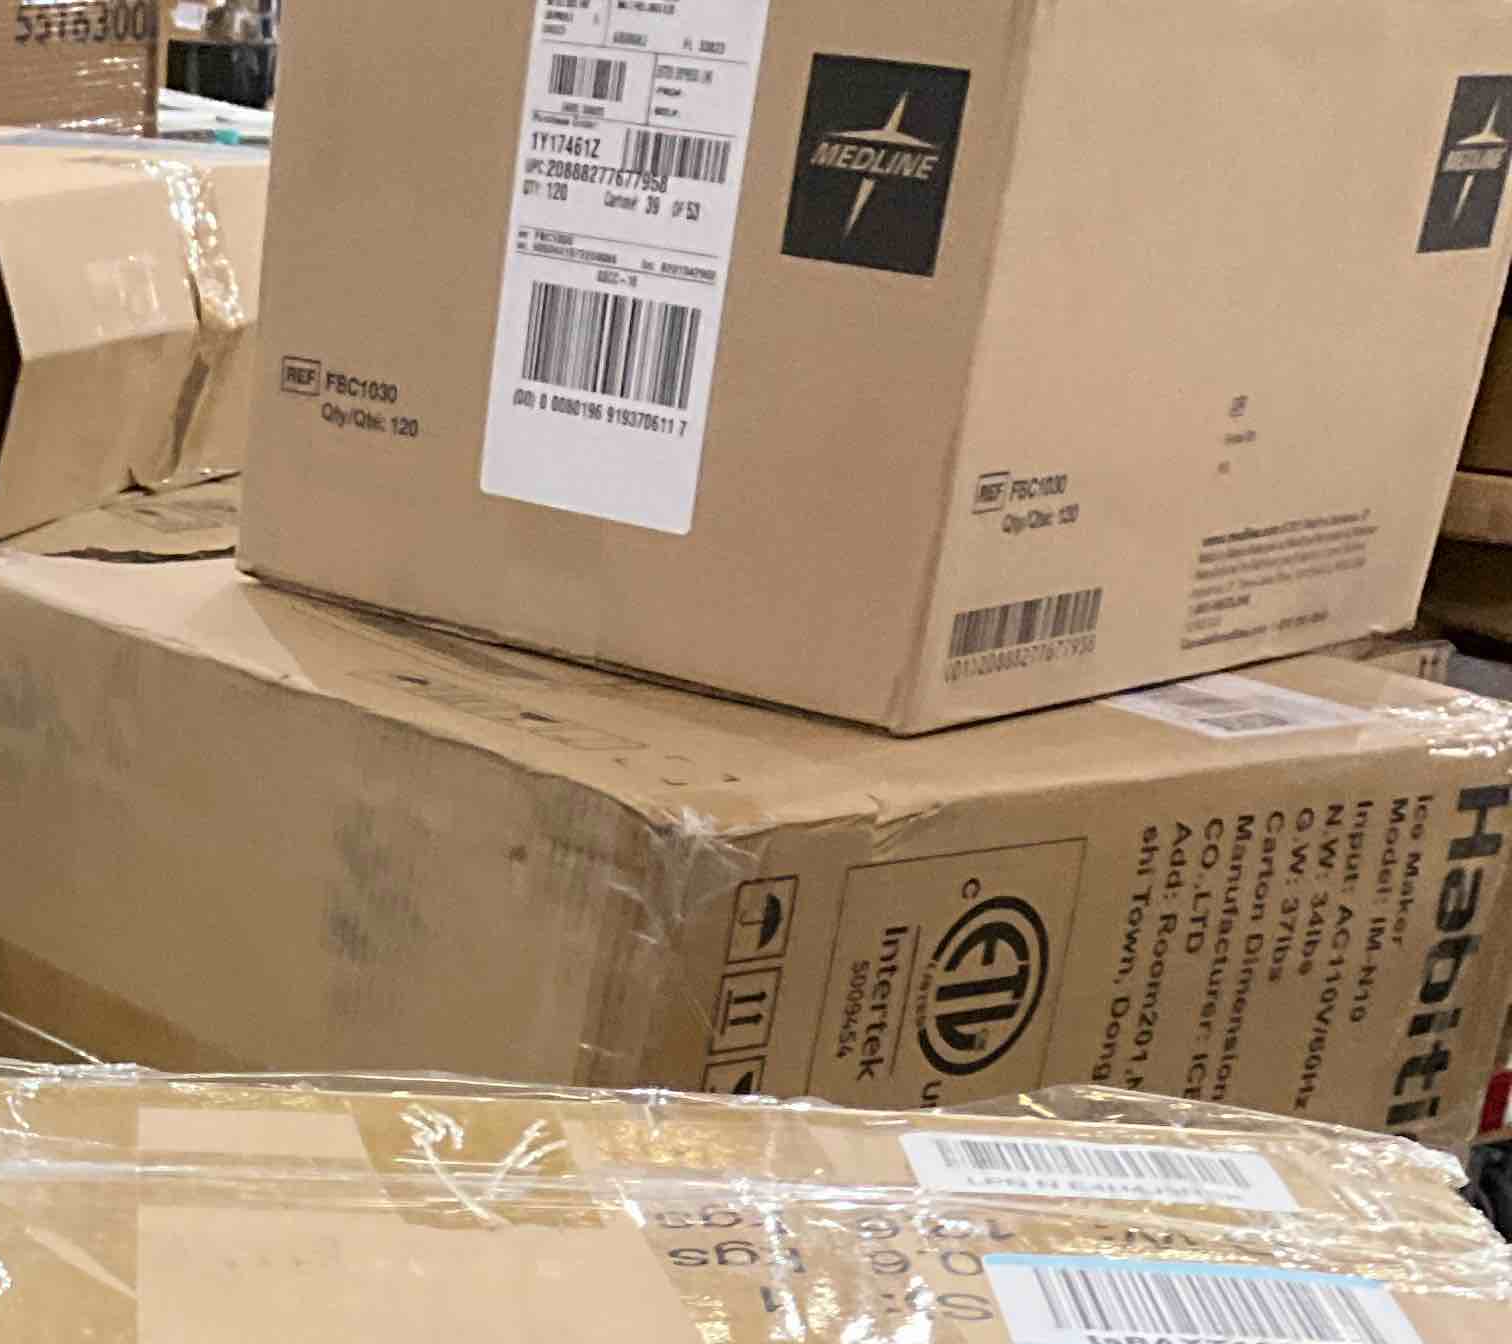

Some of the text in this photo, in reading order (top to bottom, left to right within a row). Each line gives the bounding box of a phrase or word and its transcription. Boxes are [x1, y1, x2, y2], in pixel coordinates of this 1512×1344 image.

[810, 142, 939, 181] MEDLINE
[287, 366, 316, 385] REF
[390, 415, 419, 438] 120
[1161, 822, 1193, 899] Add:
[1250, 811, 1286, 921] Carton
[1340, 800, 1374, 894] Input:
[1375, 798, 1409, 905] Model:
[1392, 795, 1433, 947] Ice Maker
[856, 925, 910, 1082] Intertek
